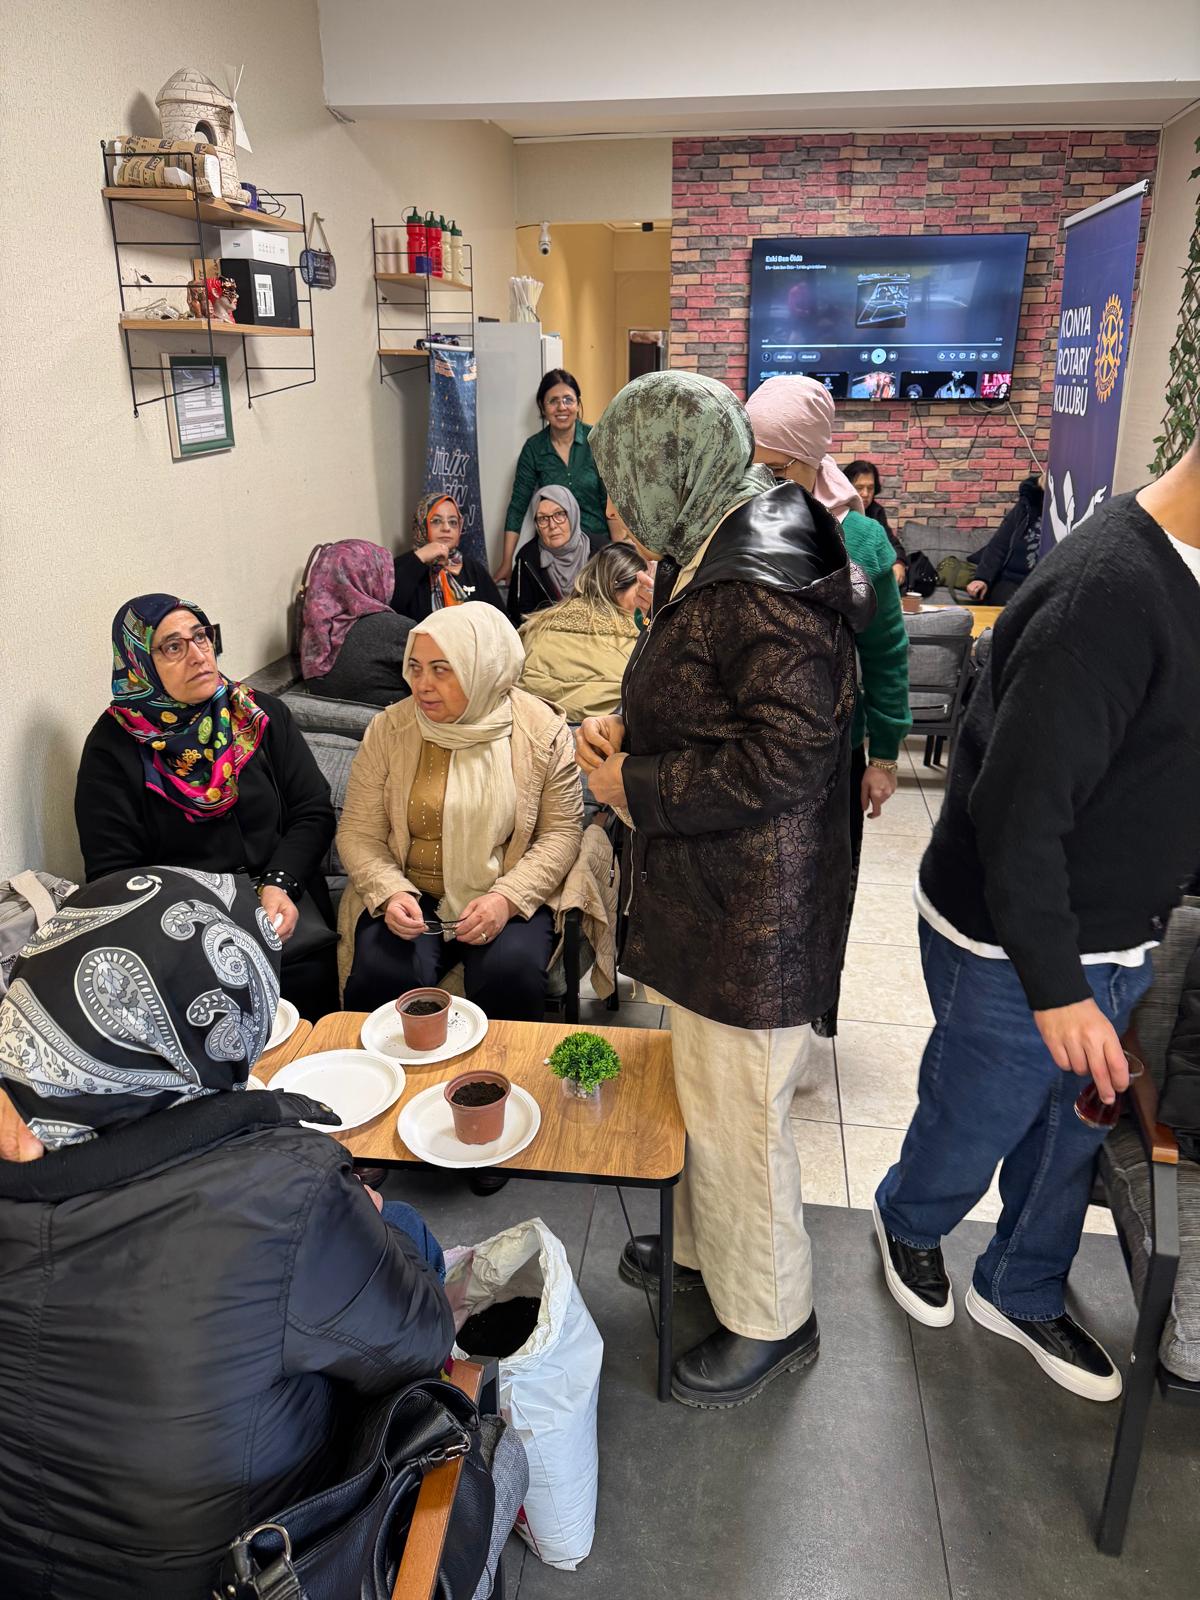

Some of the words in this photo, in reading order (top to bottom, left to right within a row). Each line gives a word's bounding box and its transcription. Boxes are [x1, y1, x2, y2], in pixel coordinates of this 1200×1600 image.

[1060, 306, 1092, 338] KONYA
[1056, 346, 1092, 376] ROTARY
[1053, 378, 1089, 417] KULÜBÜ
